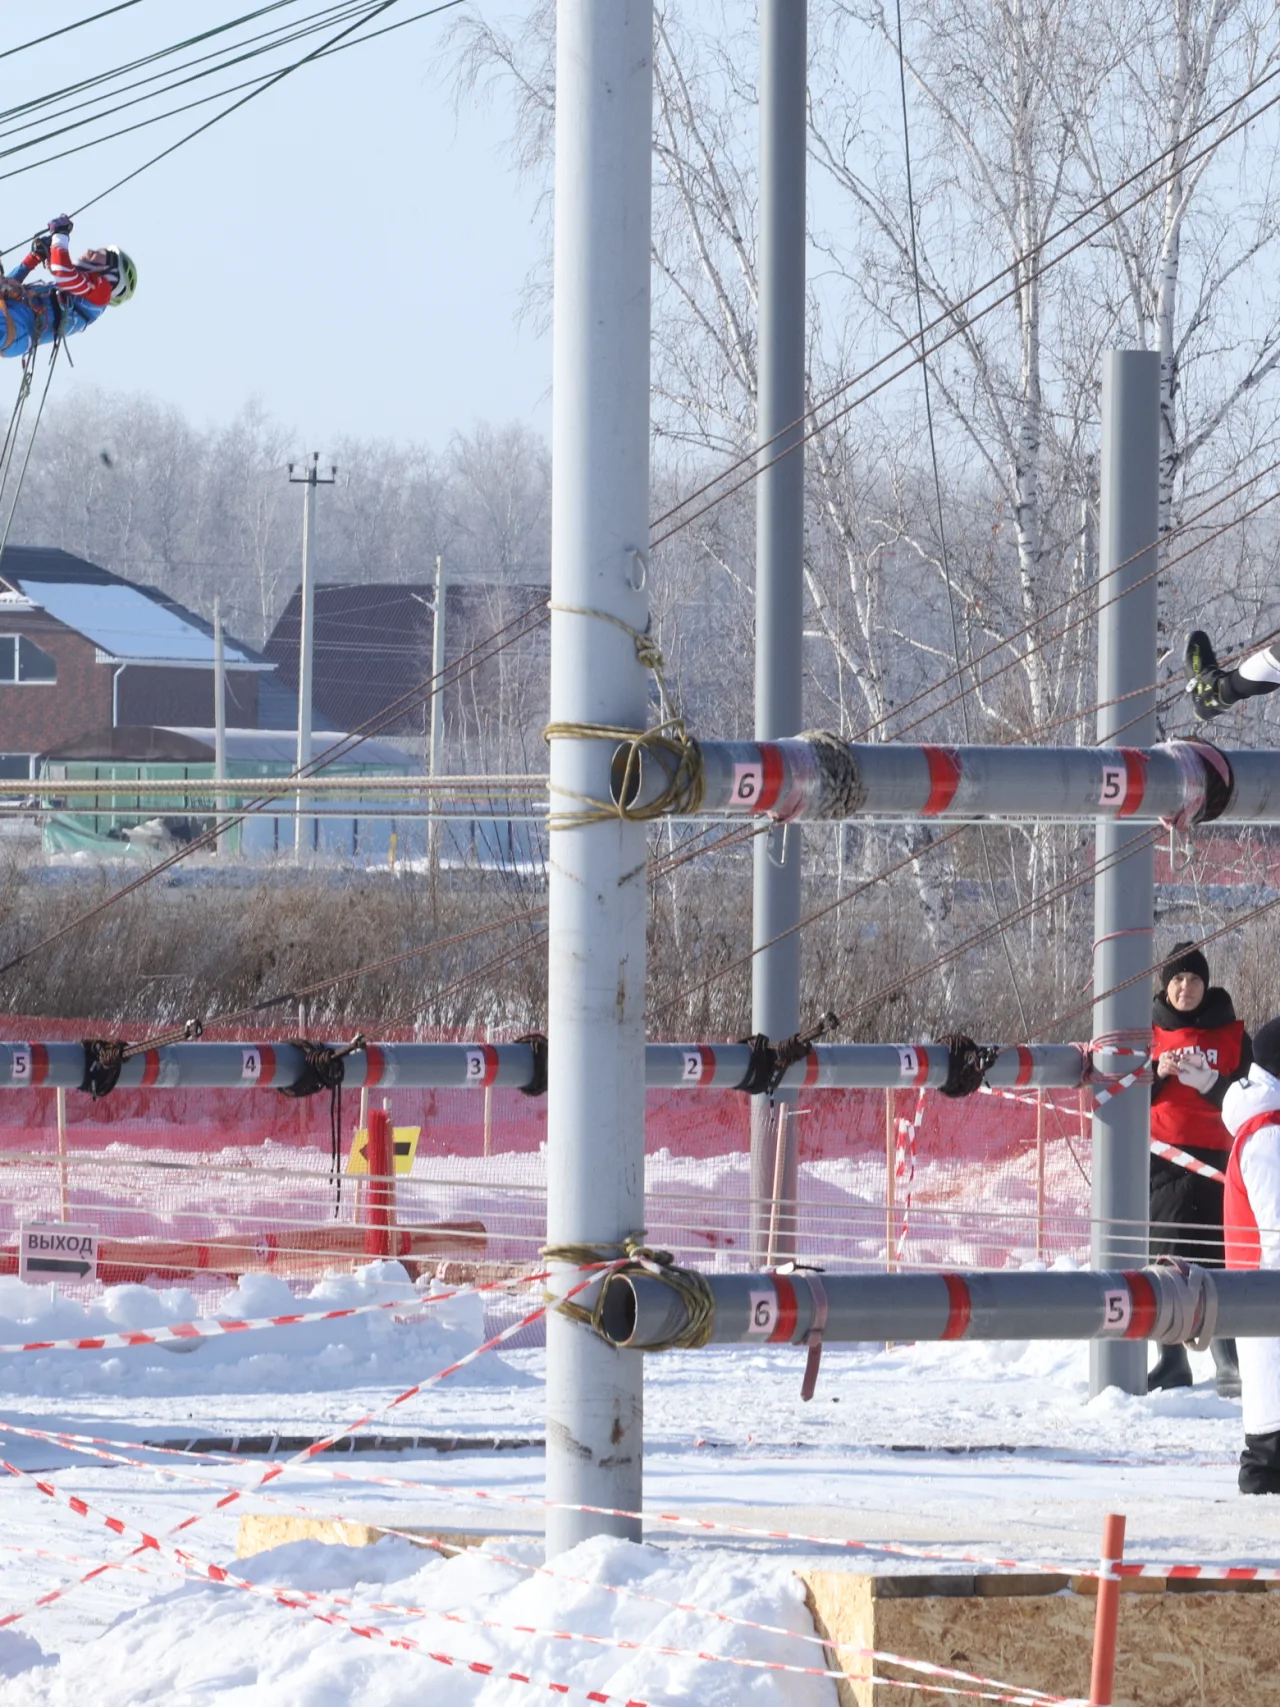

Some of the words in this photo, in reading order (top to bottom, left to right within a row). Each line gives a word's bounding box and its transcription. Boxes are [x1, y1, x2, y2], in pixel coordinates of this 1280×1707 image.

[738, 773, 754, 798] 6
[1103, 773, 1120, 798] 5
[15, 1056, 26, 1074] 5
[244, 1055, 257, 1073] 4
[471, 1057, 481, 1075] 3
[687, 1057, 698, 1075] 2
[904, 1053, 914, 1070] 1
[28, 1234, 93, 1256] ВЫХОД
[754, 1299, 770, 1327] 6
[1108, 1296, 1124, 1323] 5
